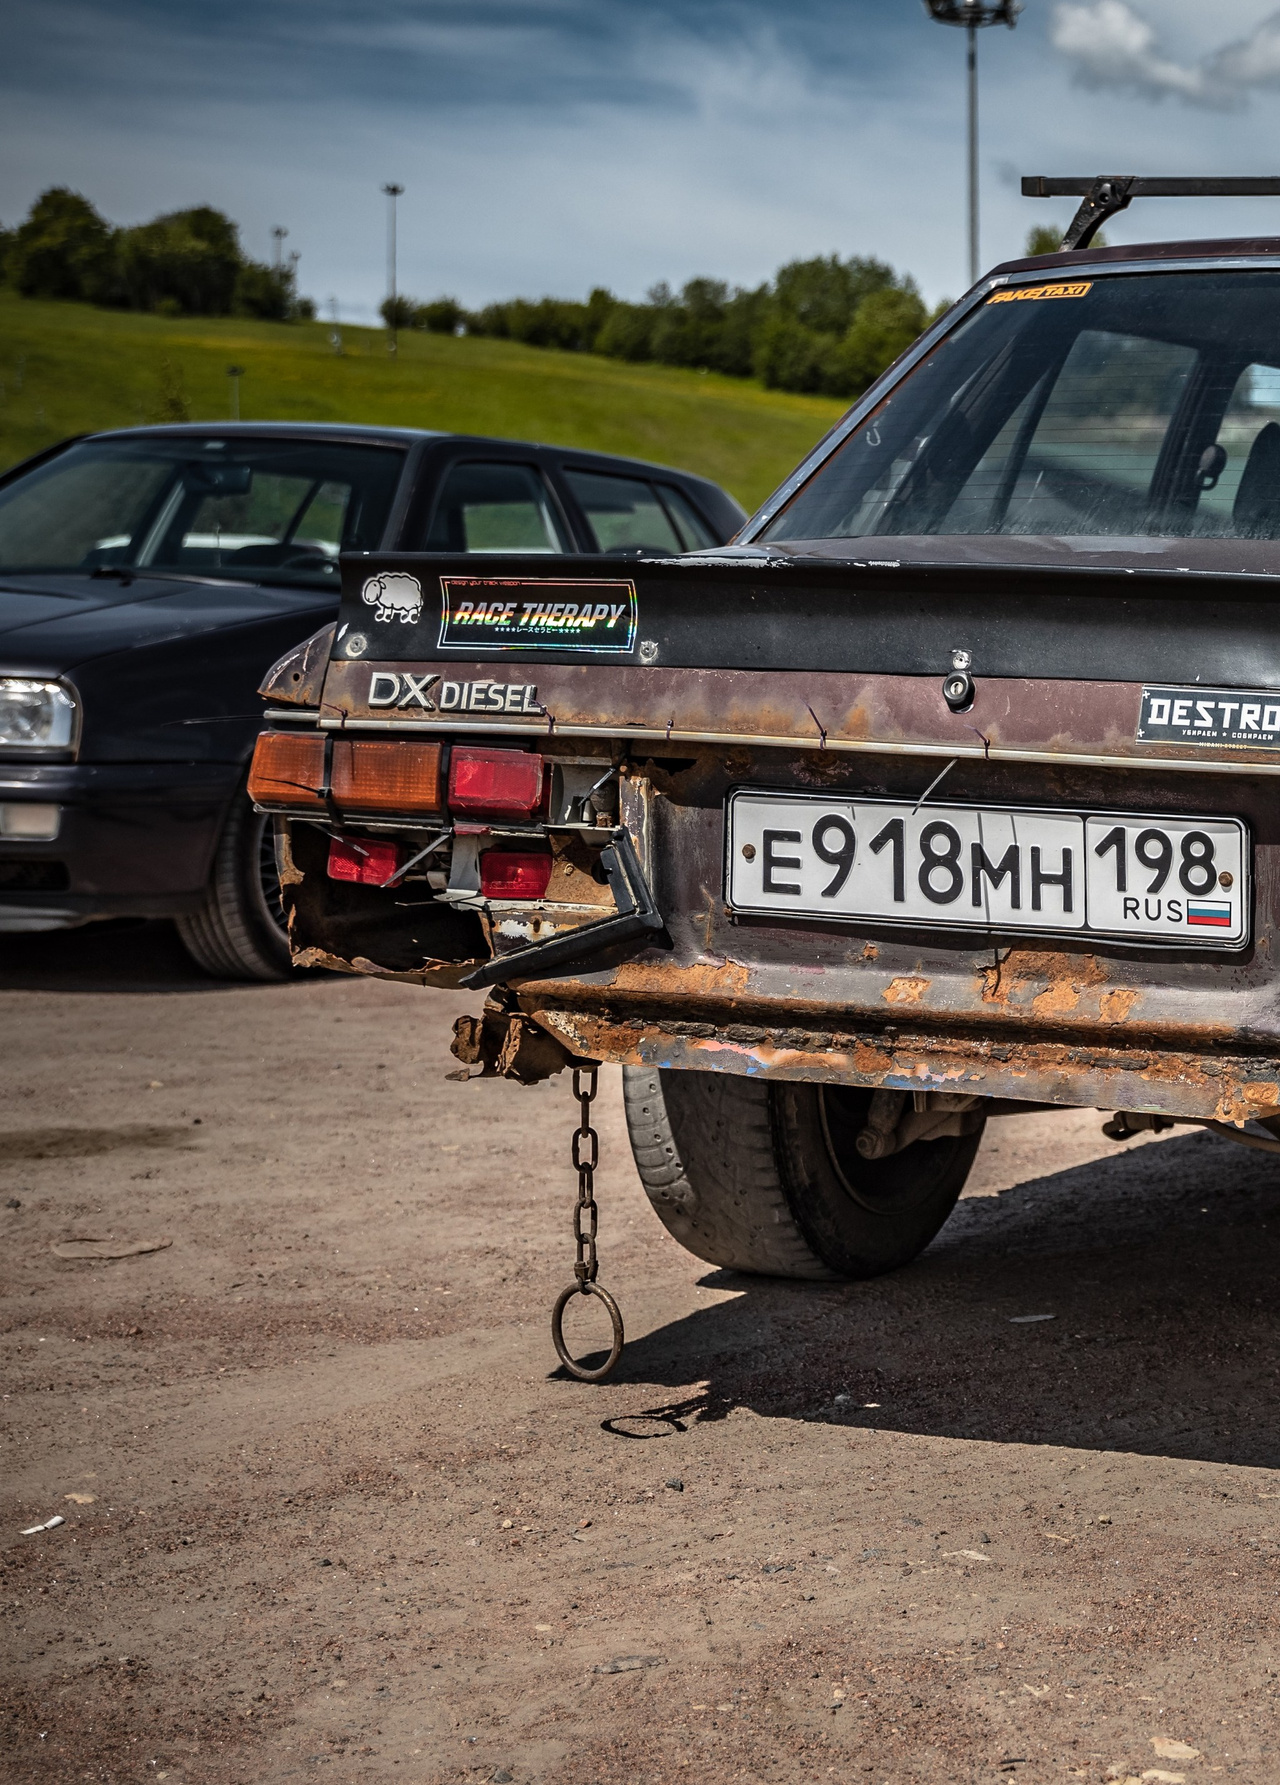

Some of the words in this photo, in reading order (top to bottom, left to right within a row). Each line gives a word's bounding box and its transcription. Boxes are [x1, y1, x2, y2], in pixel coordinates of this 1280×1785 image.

[986, 288, 1041, 304] FAKE
[1044, 285, 1083, 296] TAXI
[453, 602, 517, 625] RACE
[519, 603, 626, 628] THERAPY
[368, 671, 441, 710] DX
[440, 681, 545, 713] DIESEL
[1182, 729, 1218, 737] УБИРАЕМ
[1231, 733, 1274, 741] СОБИРАЕМ
[1094, 826, 1217, 896] 198
[1123, 897, 1183, 923] RUS
